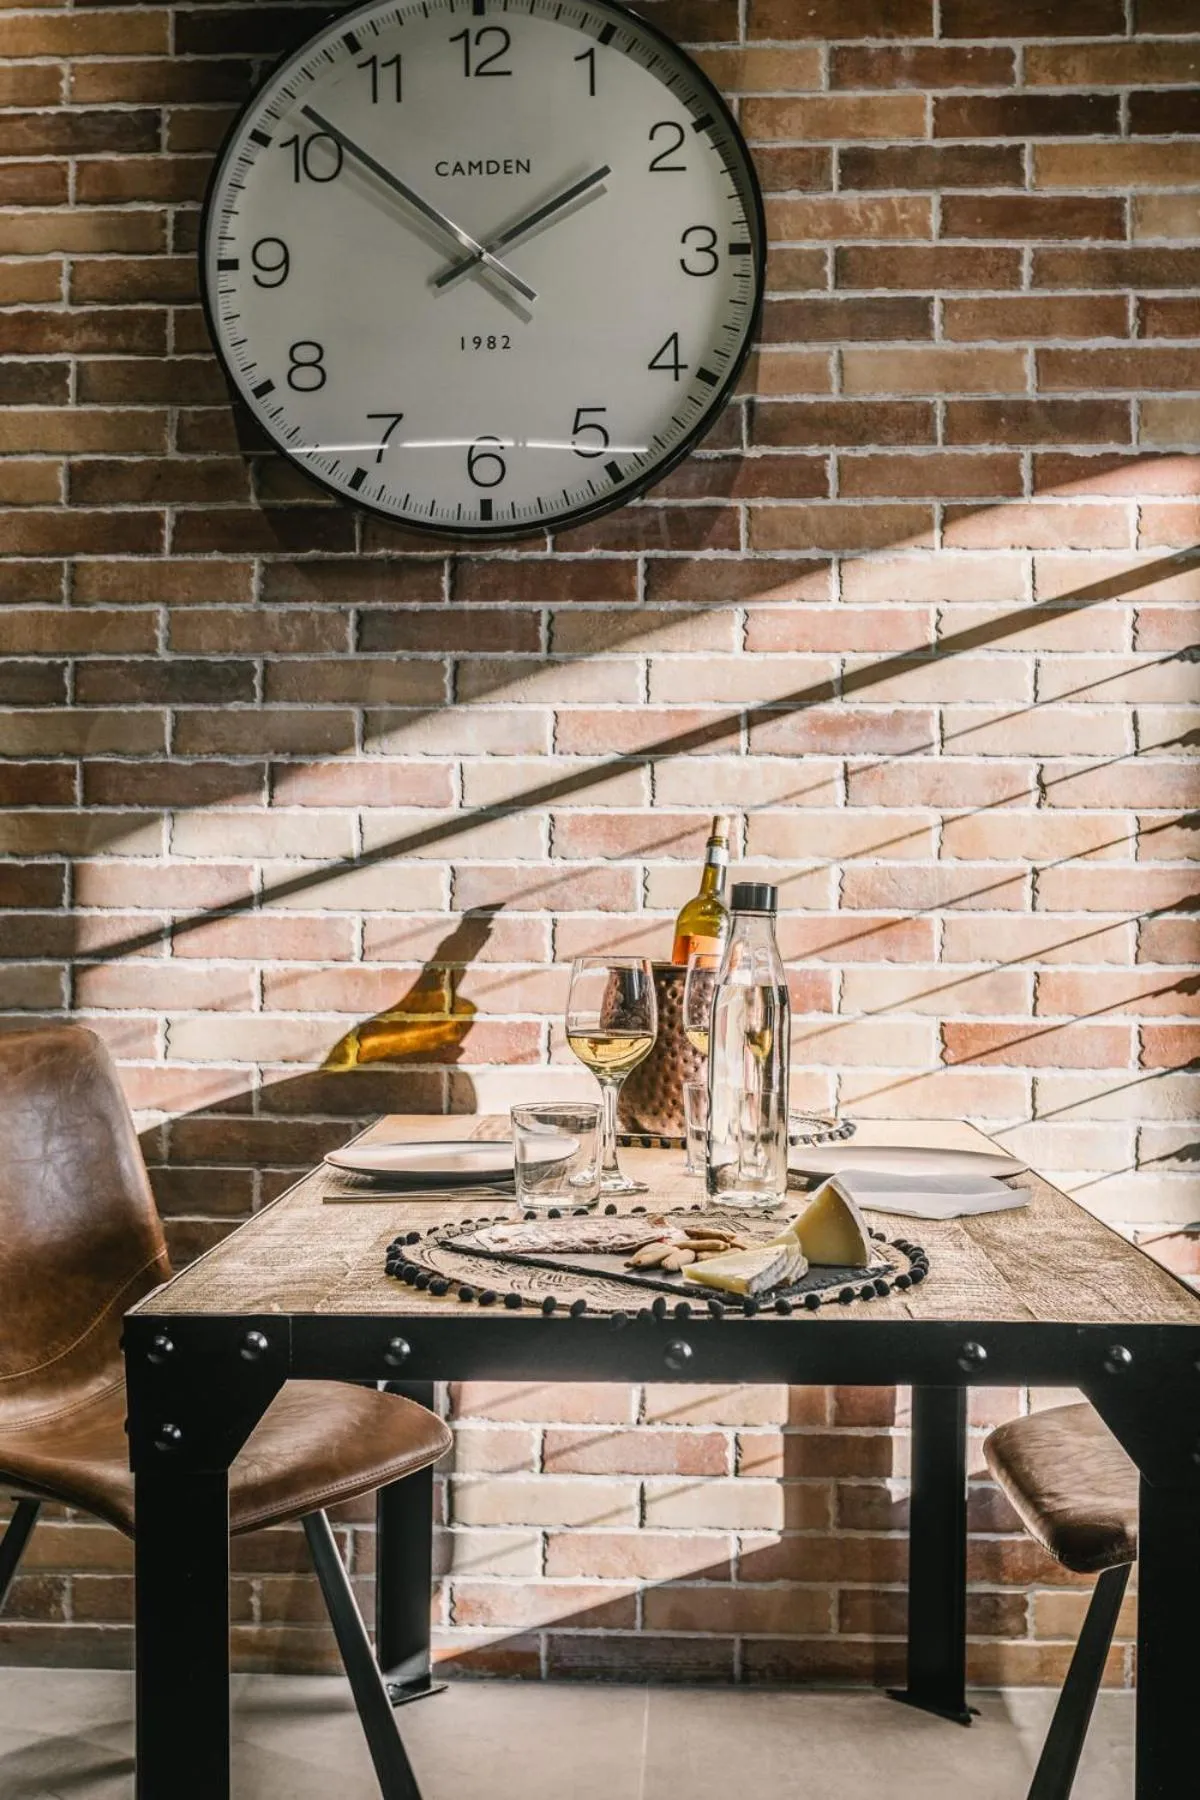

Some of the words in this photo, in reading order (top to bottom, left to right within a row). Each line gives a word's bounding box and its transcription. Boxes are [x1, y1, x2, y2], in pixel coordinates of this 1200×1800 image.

[449, 27, 512, 78] 12
[573, 47, 596, 97] 1
[357, 54, 403, 104] 11
[279, 131, 344, 184] 10
[434, 158, 531, 177] CAMDEN
[648, 121, 687, 173] 2
[251, 237, 290, 289] 9
[679, 225, 719, 277] 3
[286, 341, 327, 392] 8
[460, 335, 512, 351] 1982
[647, 332, 689, 382] 4
[366, 412, 405, 464] 7
[571, 407, 610, 459] 5
[466, 435, 507, 489] 6
